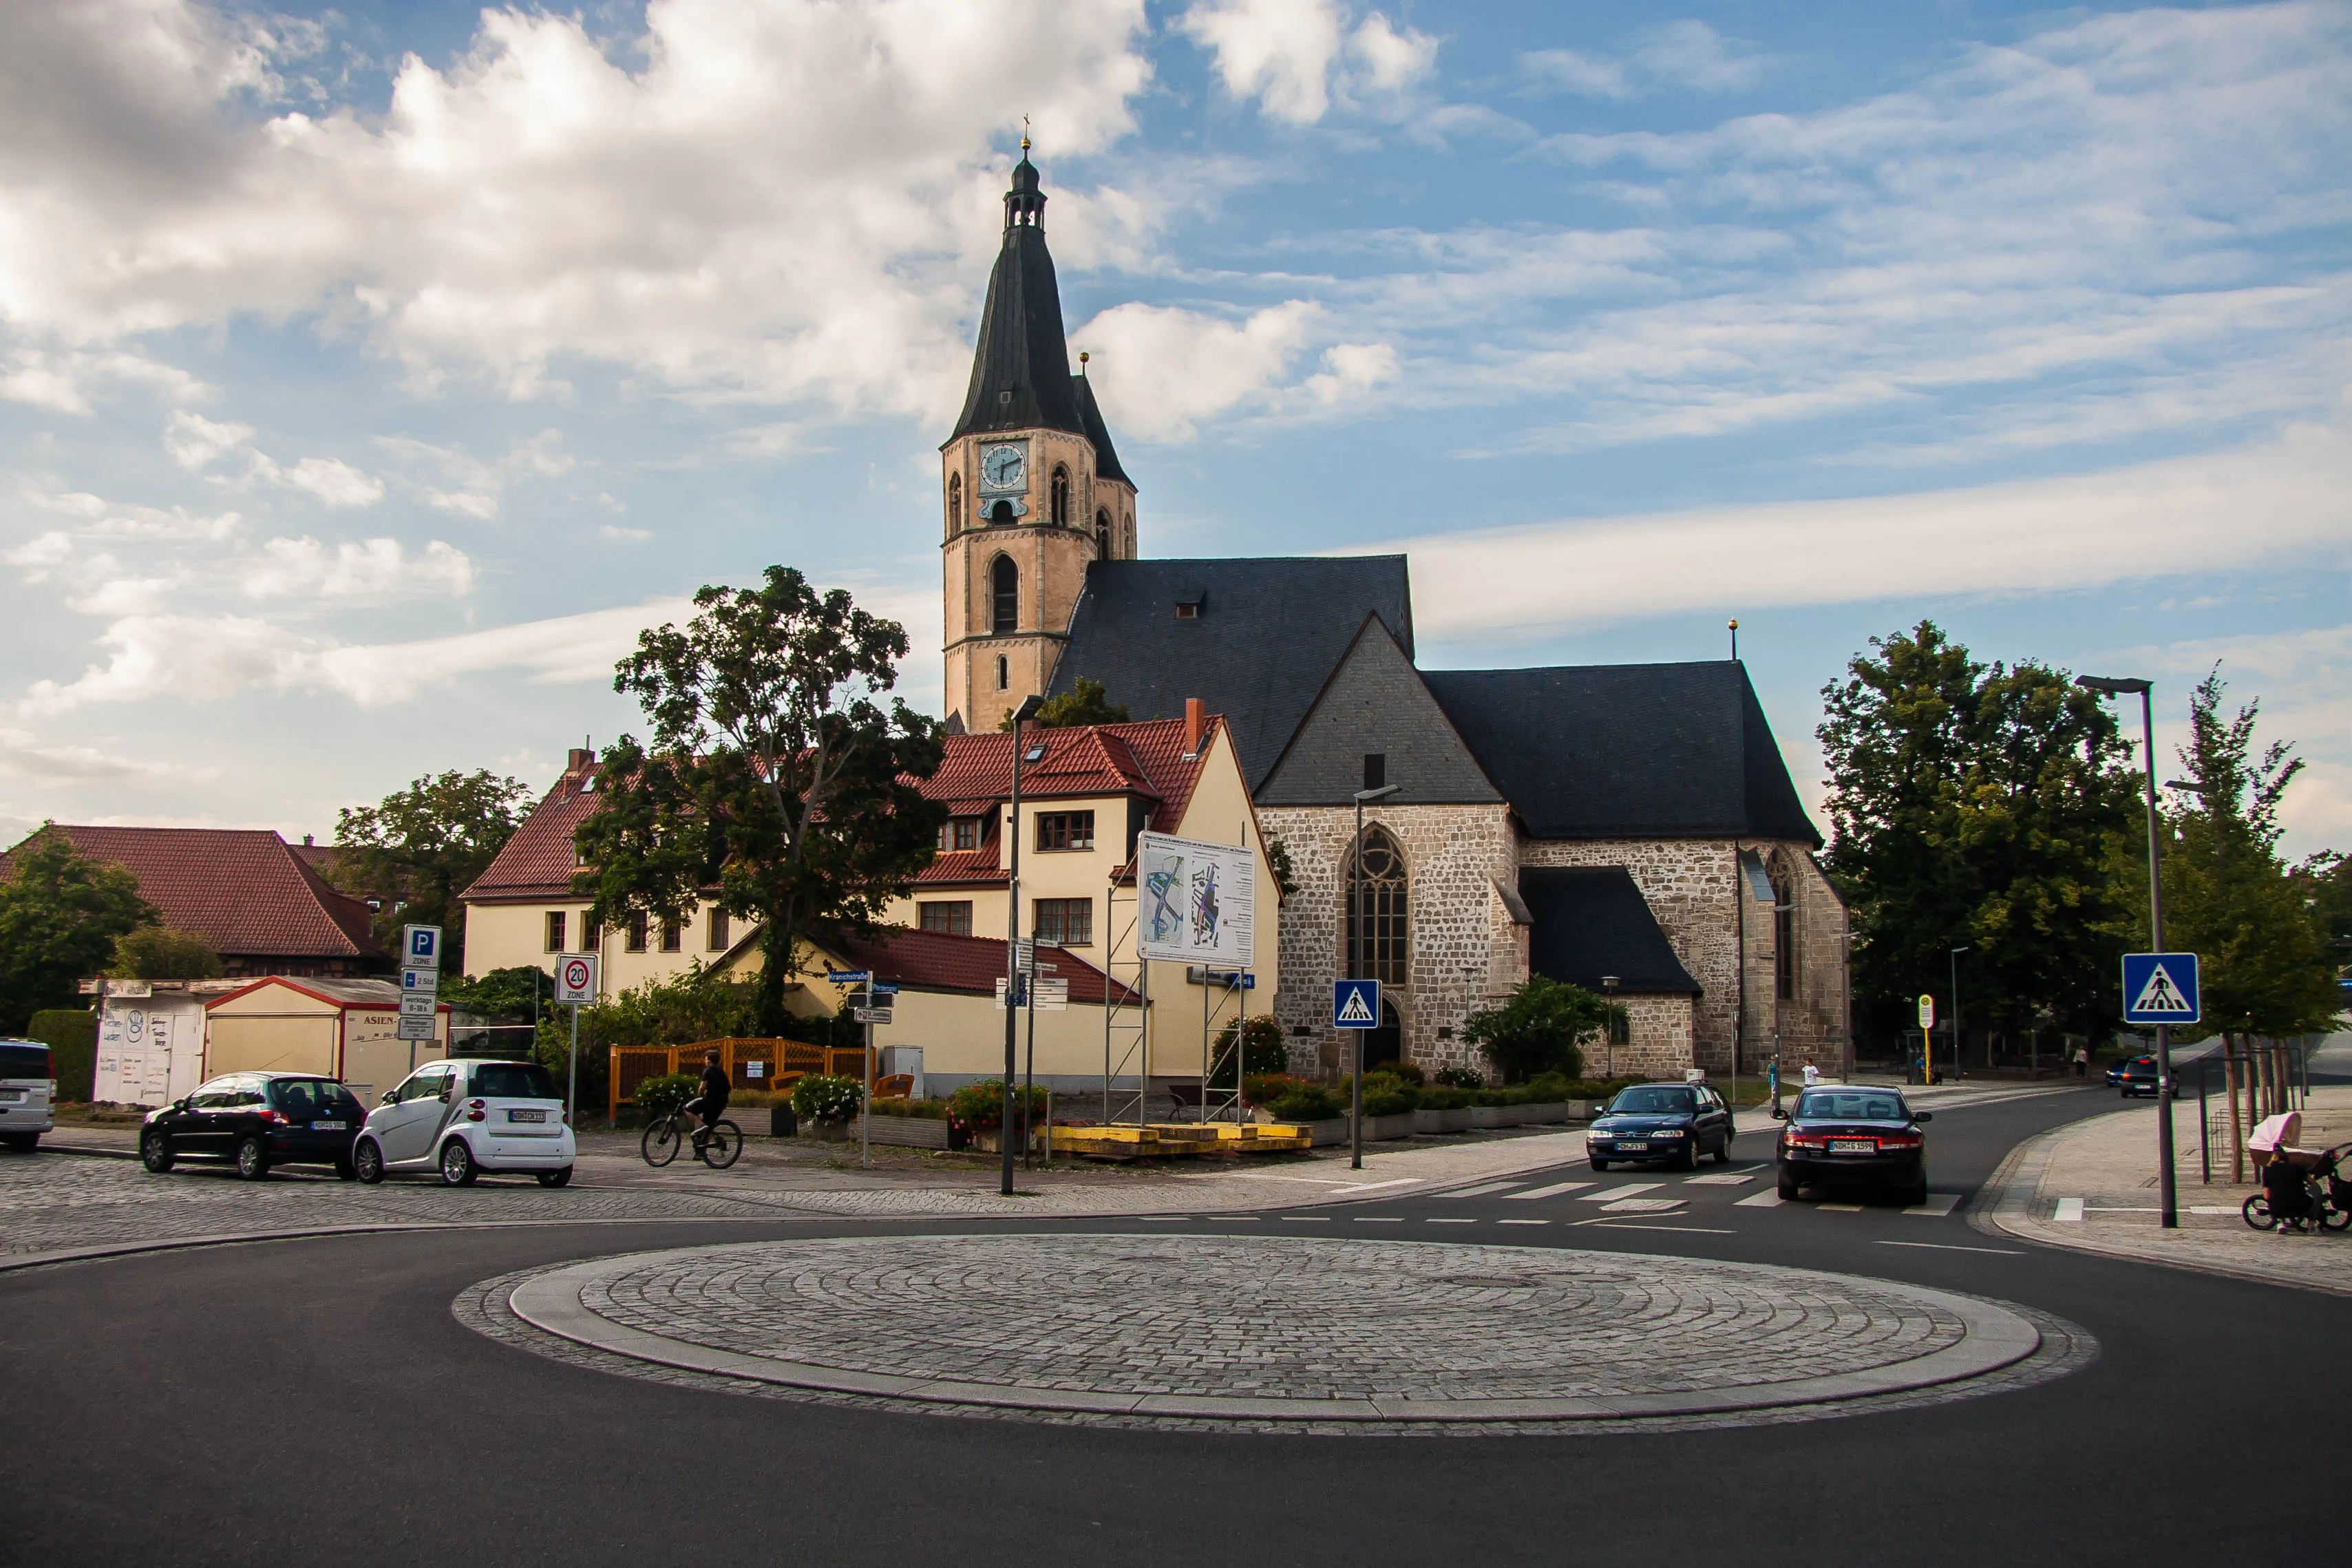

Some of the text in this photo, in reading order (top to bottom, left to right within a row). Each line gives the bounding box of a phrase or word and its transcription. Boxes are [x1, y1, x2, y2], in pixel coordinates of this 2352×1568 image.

[416, 934, 429, 951] P
[413, 957, 431, 966] ZONE
[570, 968, 584, 982] 20
